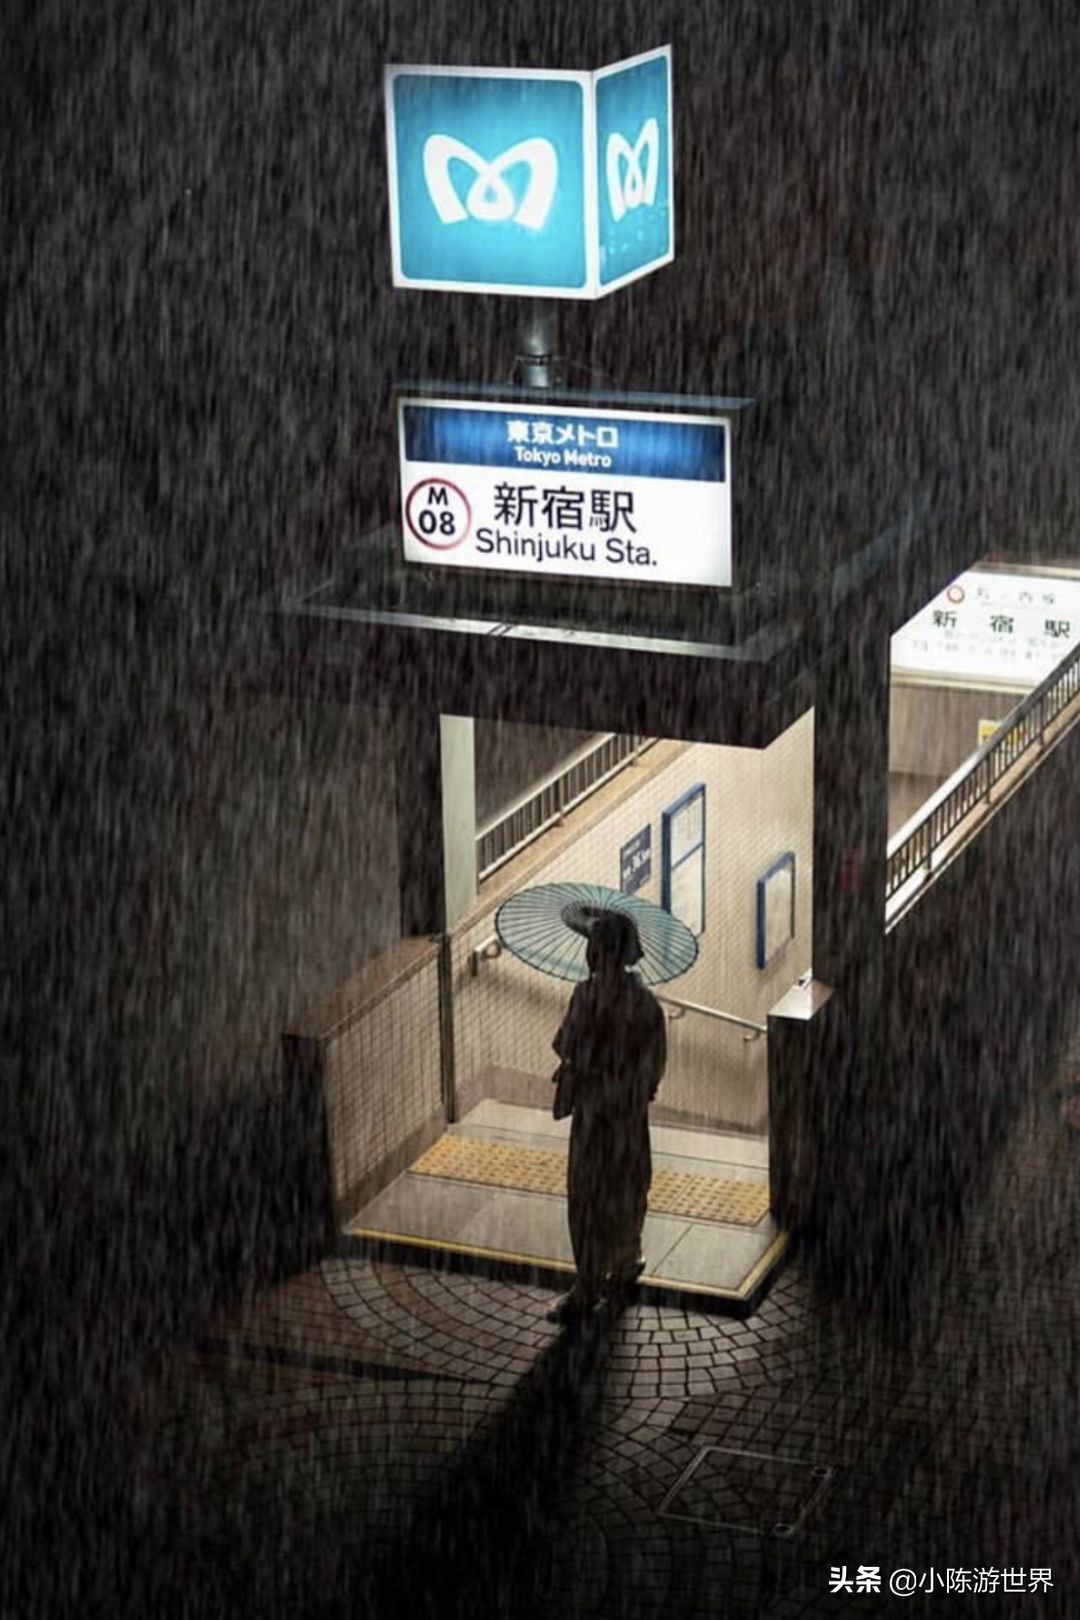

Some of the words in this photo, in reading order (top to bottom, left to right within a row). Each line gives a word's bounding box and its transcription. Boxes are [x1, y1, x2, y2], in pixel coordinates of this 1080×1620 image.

[507, 420, 618, 447] 東京メトロ
[514, 446, 561, 467] Tokyo
[564, 449, 612, 467] Metro
[427, 486, 449, 506] M
[494, 481, 637, 533] 新宿駅
[418, 510, 455, 535] 08
[475, 528, 595, 562] Shinjuku
[605, 538, 657, 566] Sta.
